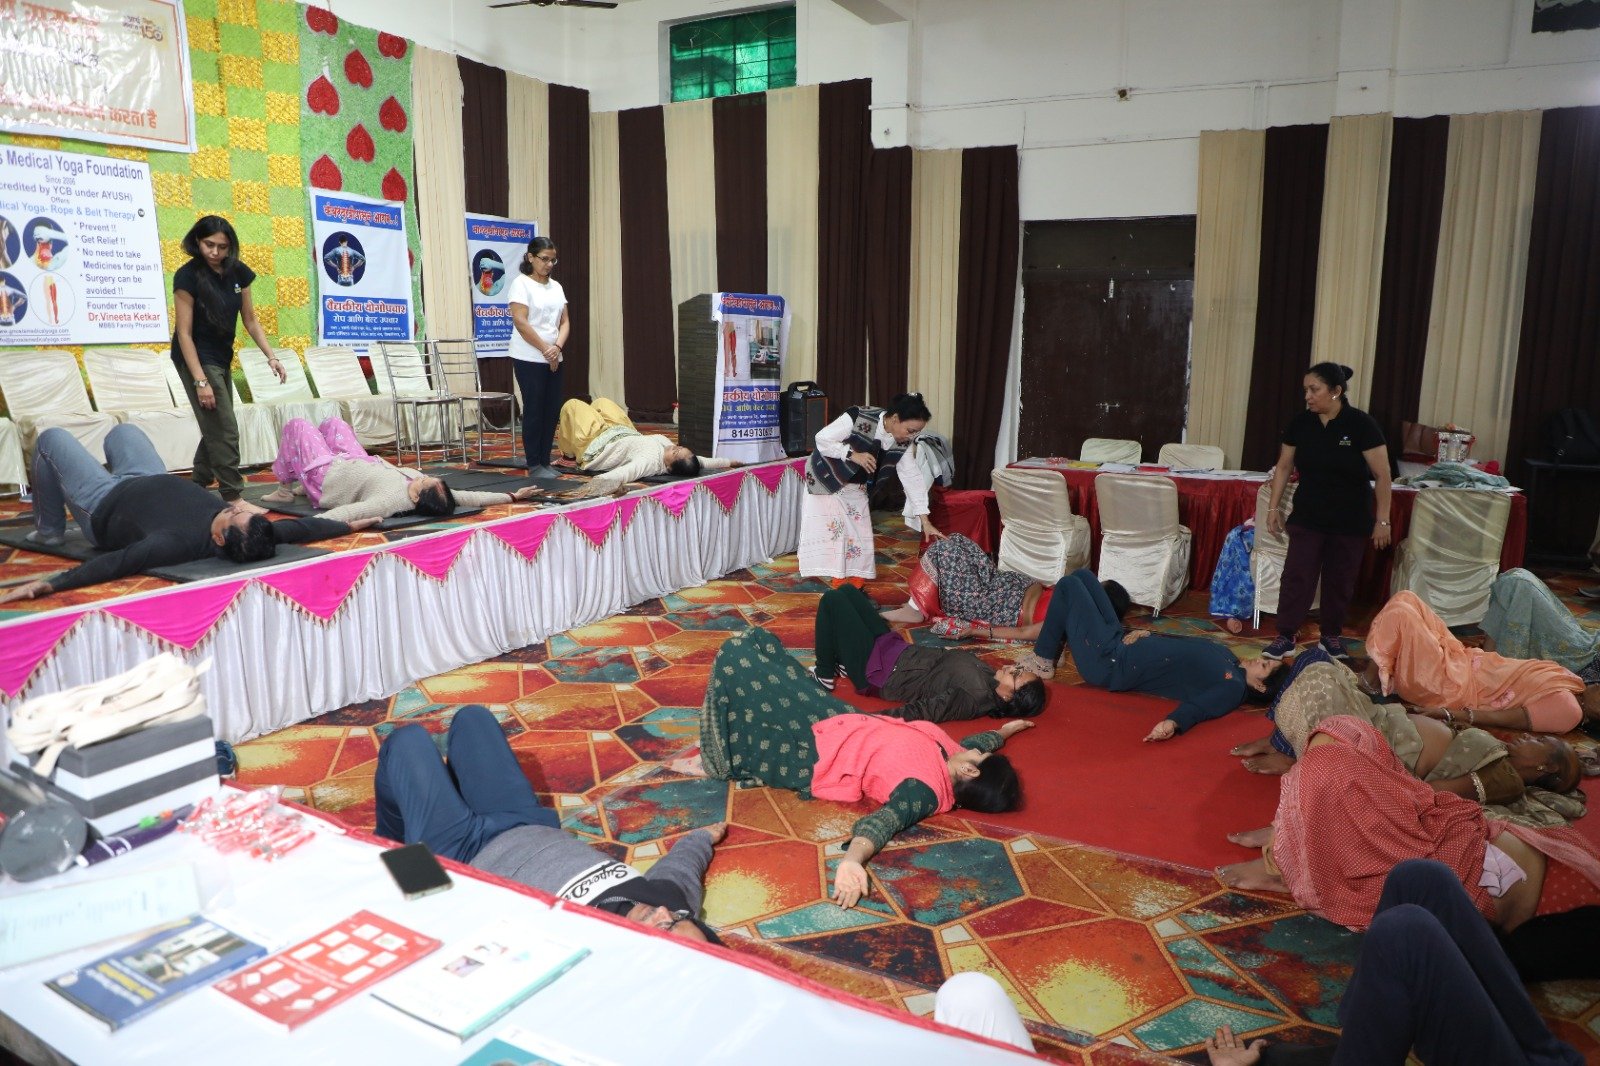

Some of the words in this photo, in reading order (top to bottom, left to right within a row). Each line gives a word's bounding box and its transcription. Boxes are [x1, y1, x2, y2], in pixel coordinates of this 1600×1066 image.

[110, 107, 144, 127] करता
[148, 109, 157, 129] है
[7, 150, 52, 170] Medical
[56, 155, 83, 176] Yoga
[86, 160, 143, 180] Foundation
[46, 174, 61, 184] Since
[40, 184, 50, 195] by
[53, 186, 72, 196] YCB
[75, 188, 98, 197] under
[102, 190, 133, 203] AYUSH)
[51, 204, 73, 215] Rope
[76, 207, 82, 215] &
[85, 206, 101, 216] Belt
[104, 209, 135, 221] Therapy
[80, 222, 109, 231] Prevent
[81, 235, 95, 244] Get
[97, 236, 118, 245] Relief
[82, 248, 93, 256] No
[95, 249, 114, 257] need
[116, 249, 123, 257] to
[125, 249, 141, 258] take
[83, 261, 121, 270] Medicines
[124, 262, 133, 271] for
[136, 263, 151, 272] pain
[85, 274, 115, 284] Surgery
[133, 275, 142, 283] be
[86, 286, 115, 295] avoided
[87, 302, 117, 310] Founder
[325, 298, 363, 313] वैद्यकीय
[364, 300, 406, 314] योगोपचार
[88, 313, 132, 322] Dr.Vineeta
[133, 313, 160, 321] Ketkar
[333, 314, 346, 323] रोप
[347, 314, 363, 323] आणि
[380, 316, 399, 324] उपचार
[117, 322, 133, 330] Family
